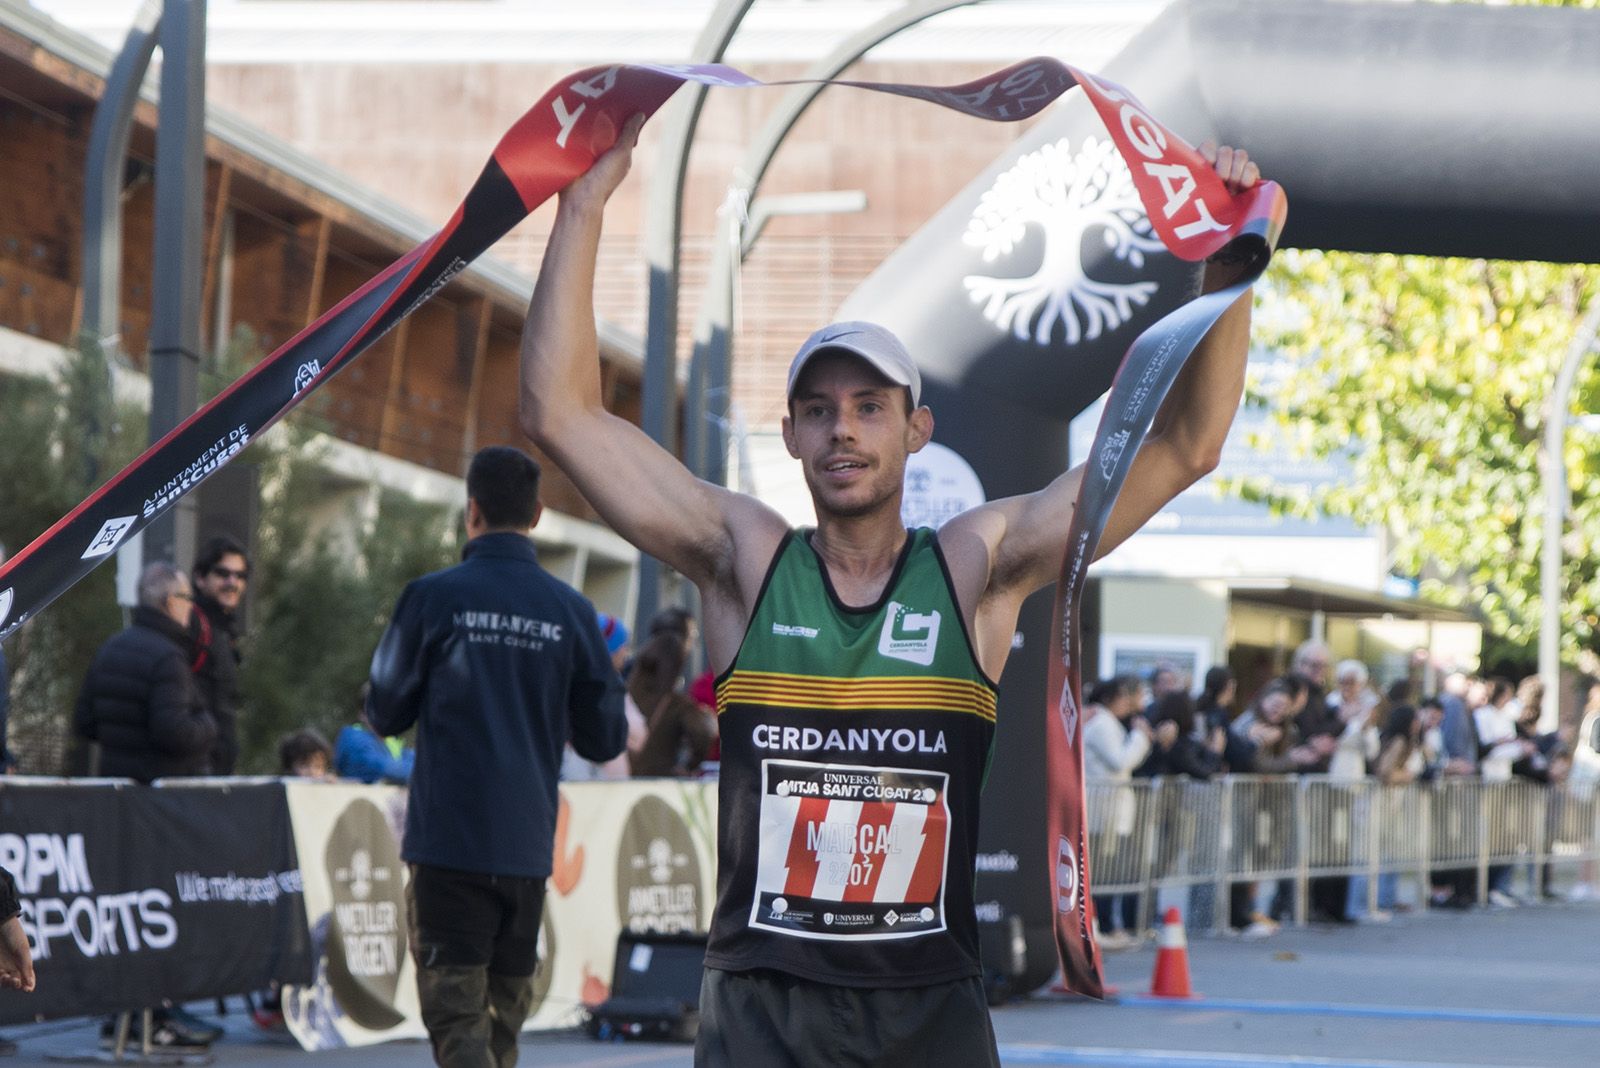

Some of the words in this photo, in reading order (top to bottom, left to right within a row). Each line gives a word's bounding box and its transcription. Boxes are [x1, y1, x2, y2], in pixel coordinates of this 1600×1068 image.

[143, 437, 226, 508] AJUNTAMENT
[229, 423, 248, 441] DE
[752, 724, 948, 753] CERDANYOLA
[823, 773, 884, 786] UNIVERSAE
[823, 783, 861, 799] SANT
[863, 786, 910, 801] CUGAT
[0, 833, 94, 894] RPM
[807, 820, 902, 864] MARÇAL
[19, 888, 178, 960] SPORTS
